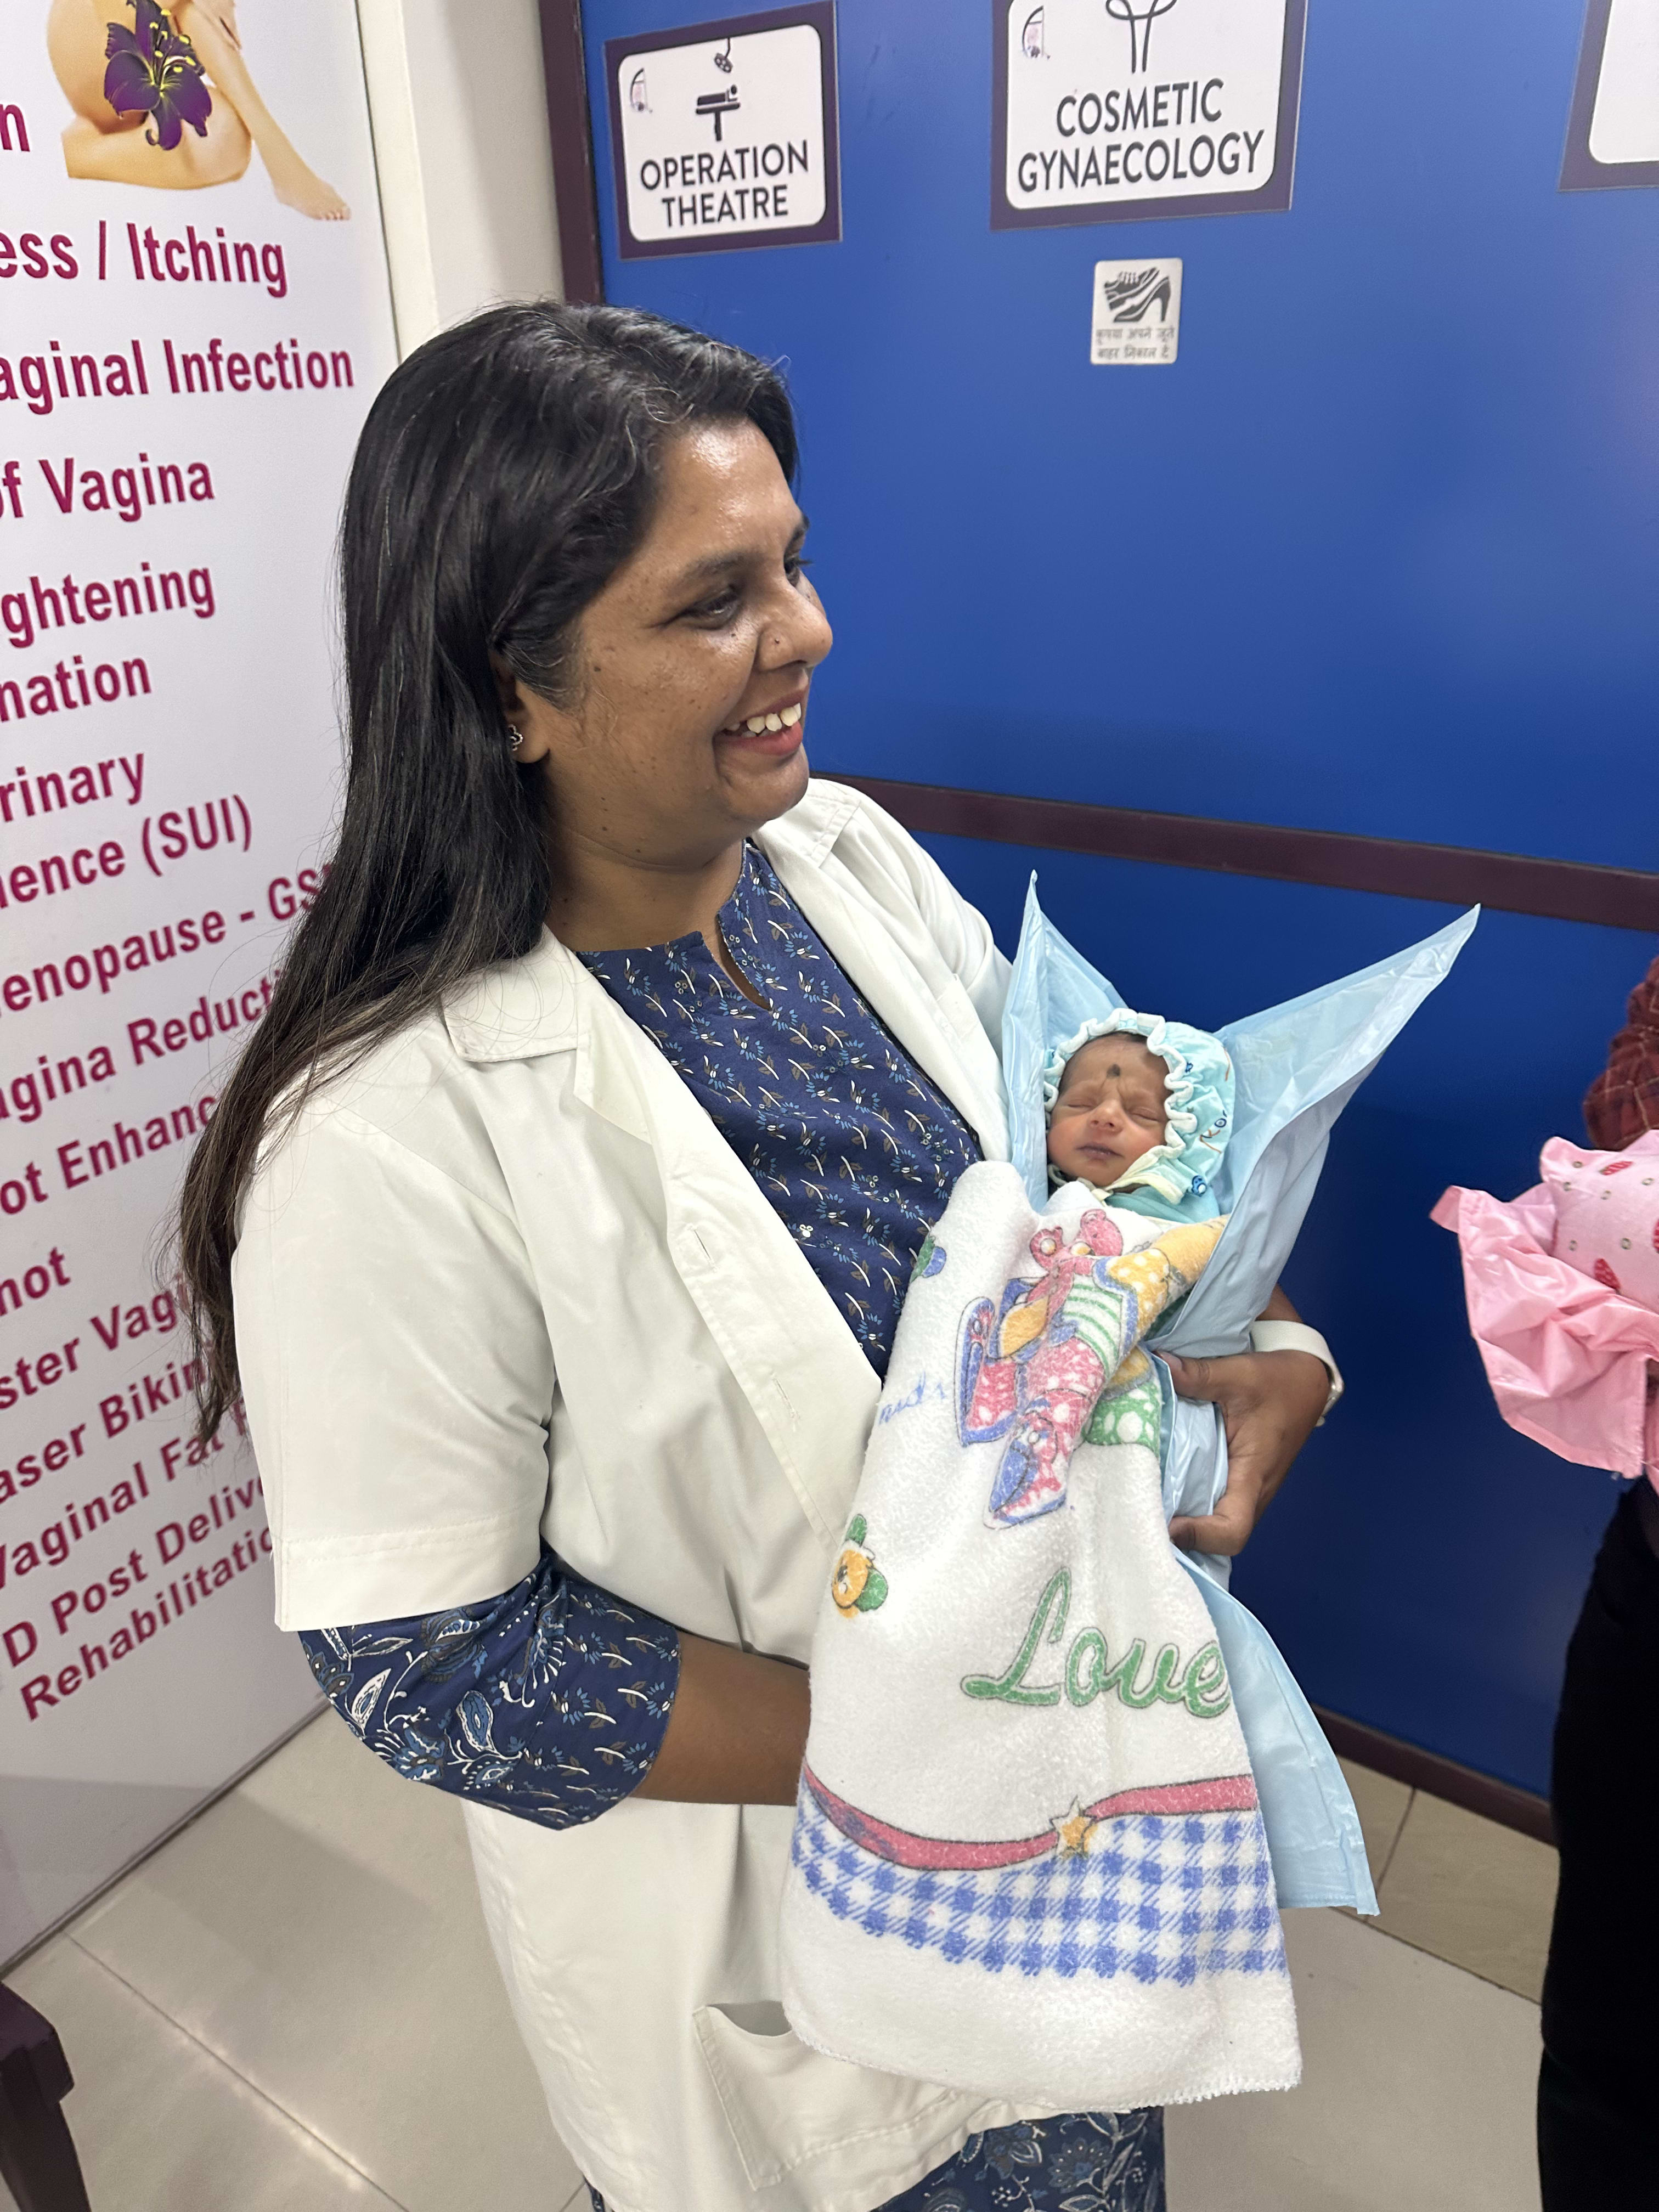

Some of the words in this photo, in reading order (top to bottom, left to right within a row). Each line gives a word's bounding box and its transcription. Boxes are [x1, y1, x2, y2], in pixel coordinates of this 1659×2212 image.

[1057, 78, 1224, 137] COSMETIC
[640, 140, 808, 190] OPERATION
[1018, 129, 1264, 193] GYNAECOLOGY
[662, 184, 788, 228] THEATRE
[0, 232, 78, 280] ess
[99, 221, 106, 280] /
[127, 222, 287, 298] Itching
[0, 339, 149, 415] aginal
[163, 337, 354, 394] Infection
[0, 460, 24, 518] f
[39, 453, 214, 523] Vagina
[1, 561, 215, 648] ghtening
[0, 655, 151, 723] nation
[0, 753, 144, 823] rinary
[0, 840, 125, 909] ence
[142, 794, 252, 877] (SUI)
[0, 911, 226, 1015] enopause
[268, 864, 331, 921] GS
[127, 969, 280, 1065] Reduct
[0, 1162, 49, 1215] ot
[0, 1338, 80, 1410] ster
[0, 1424, 86, 1505] aser
[99, 1340, 214, 1437] Bikin
[0, 1462, 149, 1589] aginal
[3, 1622, 37, 1667] D
[52, 1550, 148, 1635] Post
[960, 1567, 1231, 1718] Love
